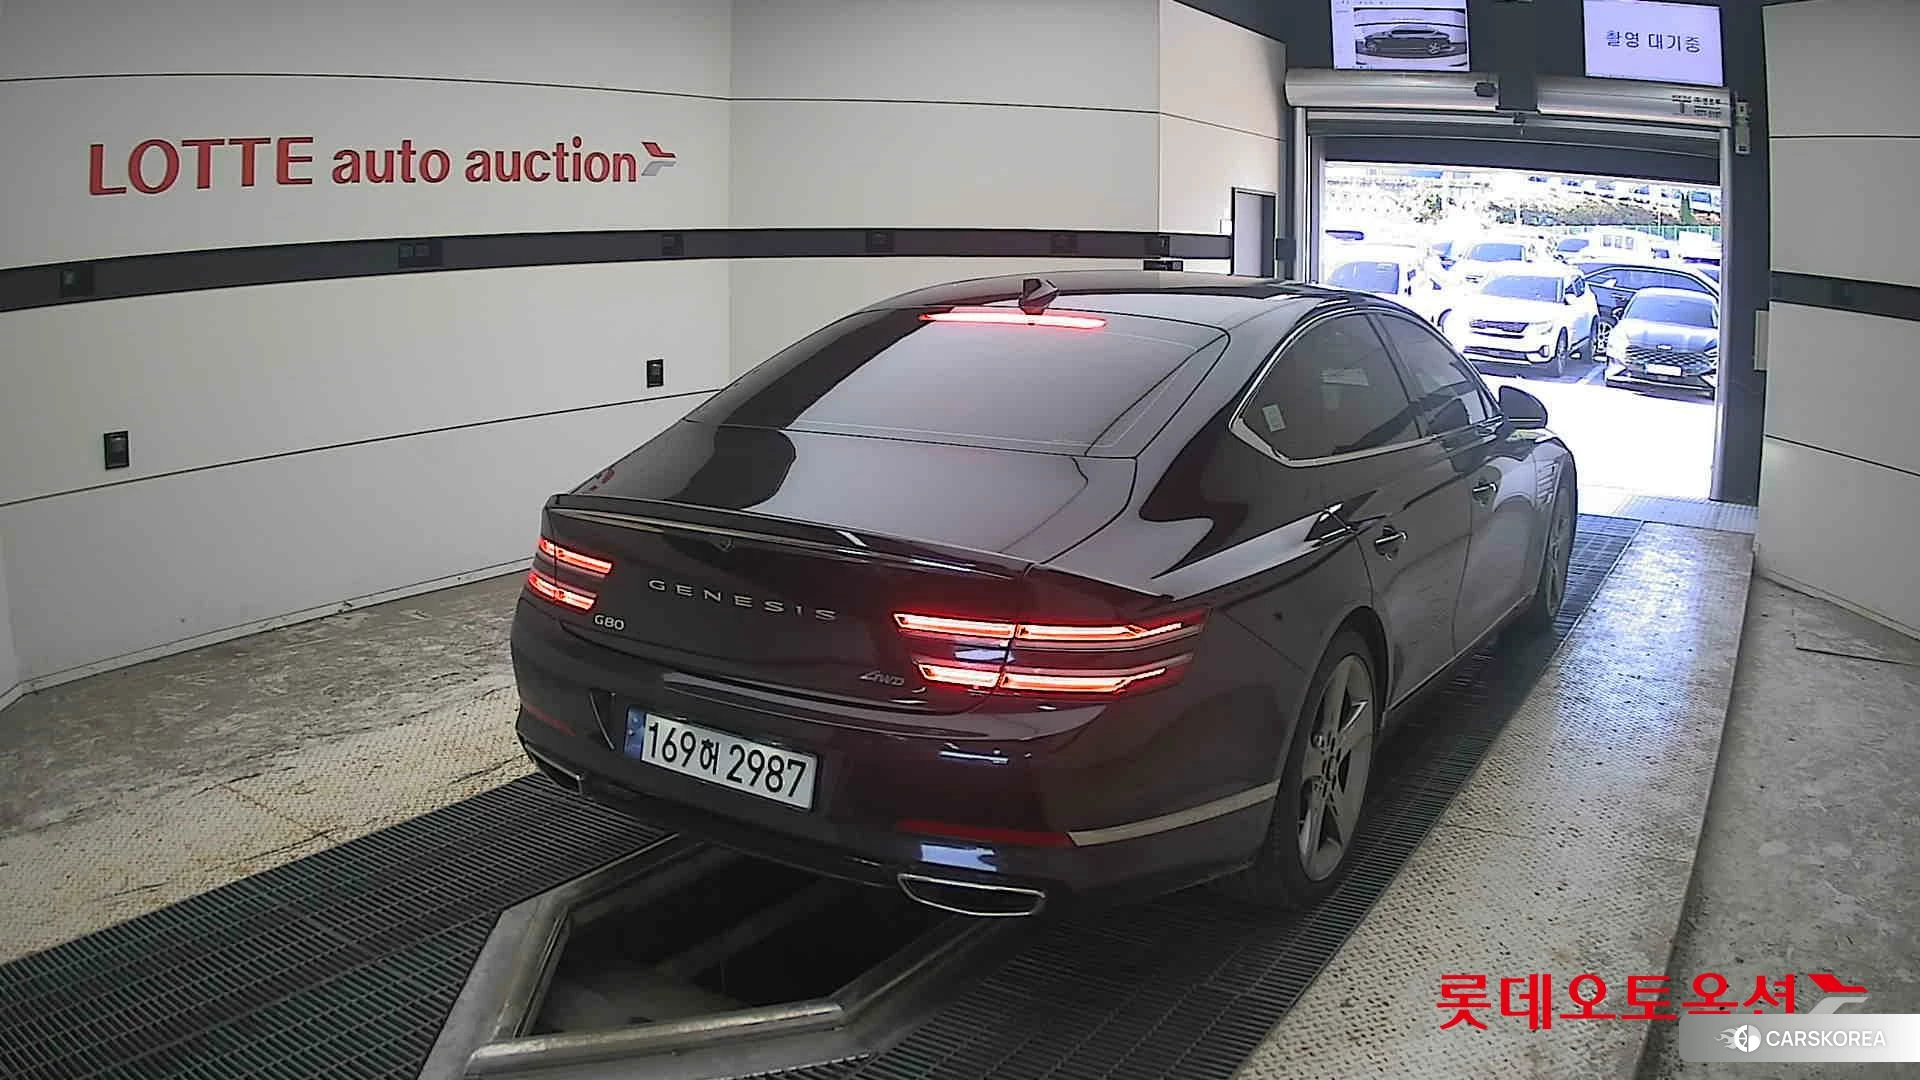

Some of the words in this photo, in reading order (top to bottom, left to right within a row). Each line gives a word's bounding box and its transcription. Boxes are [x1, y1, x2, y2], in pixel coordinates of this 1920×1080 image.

[1648, 33, 1701, 53] 대기중
[89, 136, 314, 196] LOTTE
[331, 139, 451, 184] auto
[463, 136, 638, 183] auction
[648, 579, 837, 621] GENESIS
[594, 614, 625, 630] G80
[859, 670, 905, 686] 4WD
[649, 722, 720, 776] 169허
[726, 744, 807, 797] 2987
